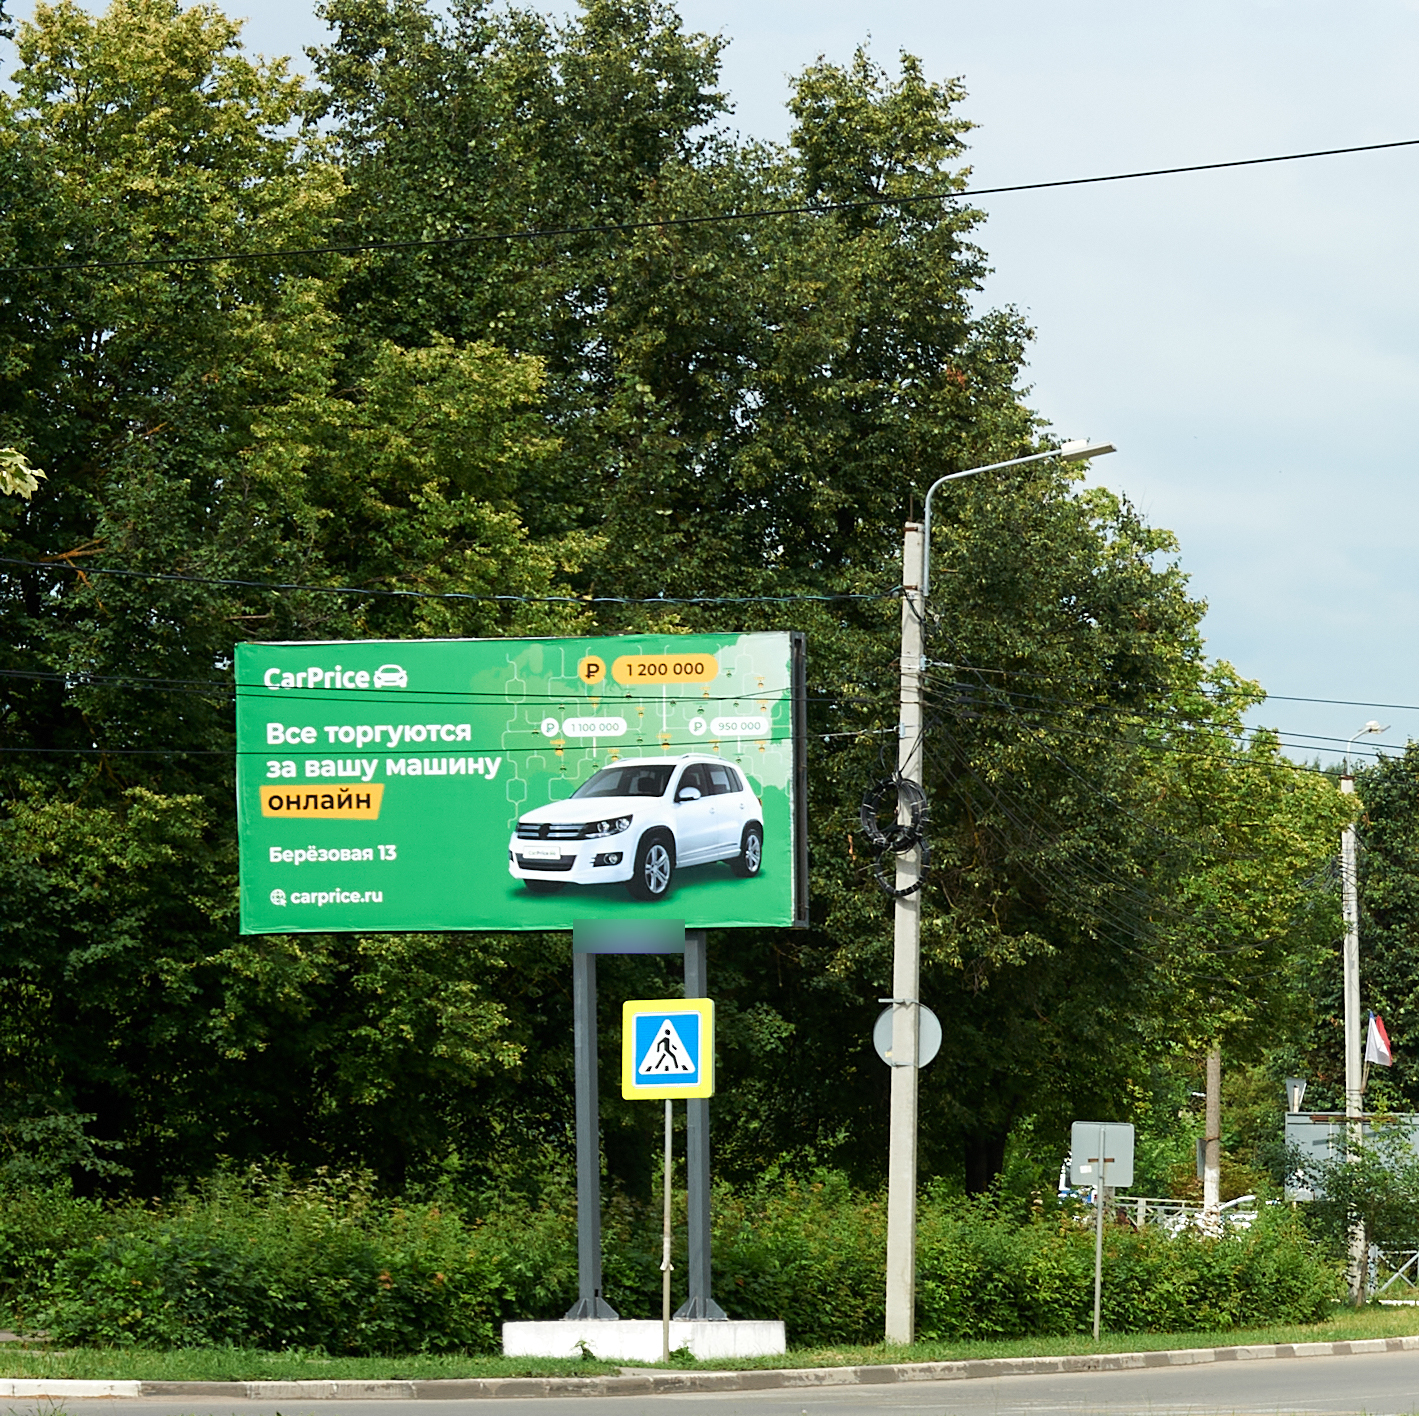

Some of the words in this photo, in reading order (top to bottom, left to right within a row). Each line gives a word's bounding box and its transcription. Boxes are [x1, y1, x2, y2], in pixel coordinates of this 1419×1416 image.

[264, 665, 371, 691] CarPrice
[638, 663, 668, 676] 200
[673, 662, 705, 676] 000
[266, 722, 318, 745] Все
[324, 723, 472, 748] торгуются
[718, 722, 738, 731] 950
[740, 722, 761, 731] 000
[266, 759, 297, 778] за
[305, 758, 379, 782] вашу
[386, 756, 502, 780] машину
[268, 787, 372, 811] онлайн
[269, 845, 374, 866] Берёзовая
[377, 844, 398, 861] 13
[290, 887, 384, 907] carprice.ru
